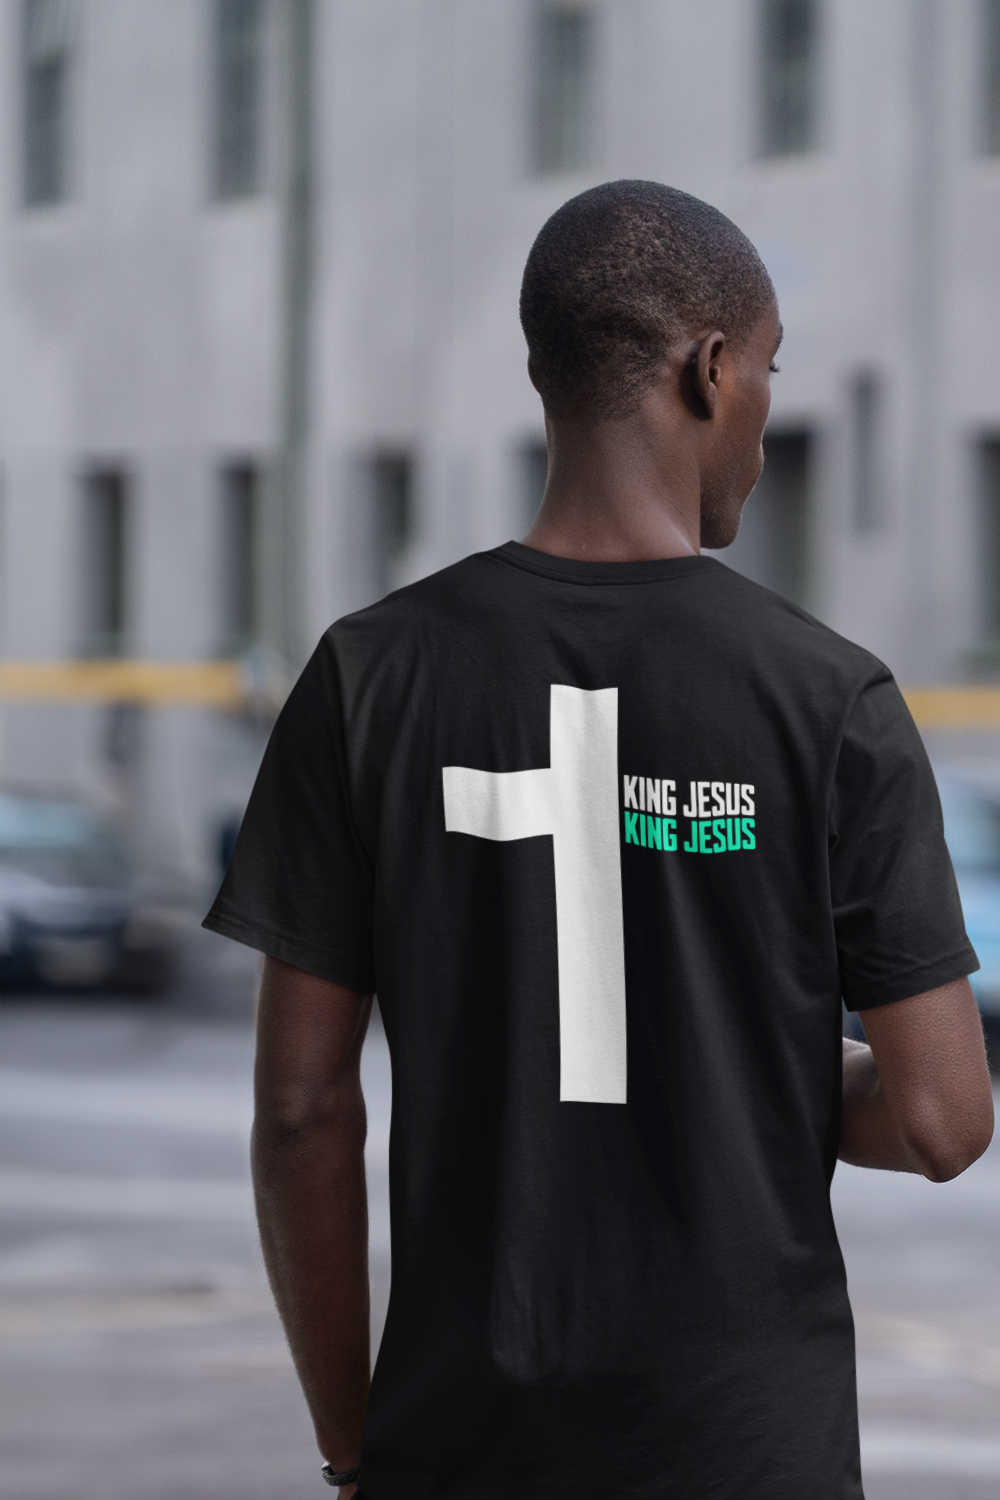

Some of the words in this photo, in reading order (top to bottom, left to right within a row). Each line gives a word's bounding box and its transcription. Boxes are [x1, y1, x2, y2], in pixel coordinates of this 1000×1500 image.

[623, 774, 677, 816] KING
[683, 781, 755, 818] JESUS
[624, 811, 678, 852] KING
[683, 818, 756, 854] JESUS
